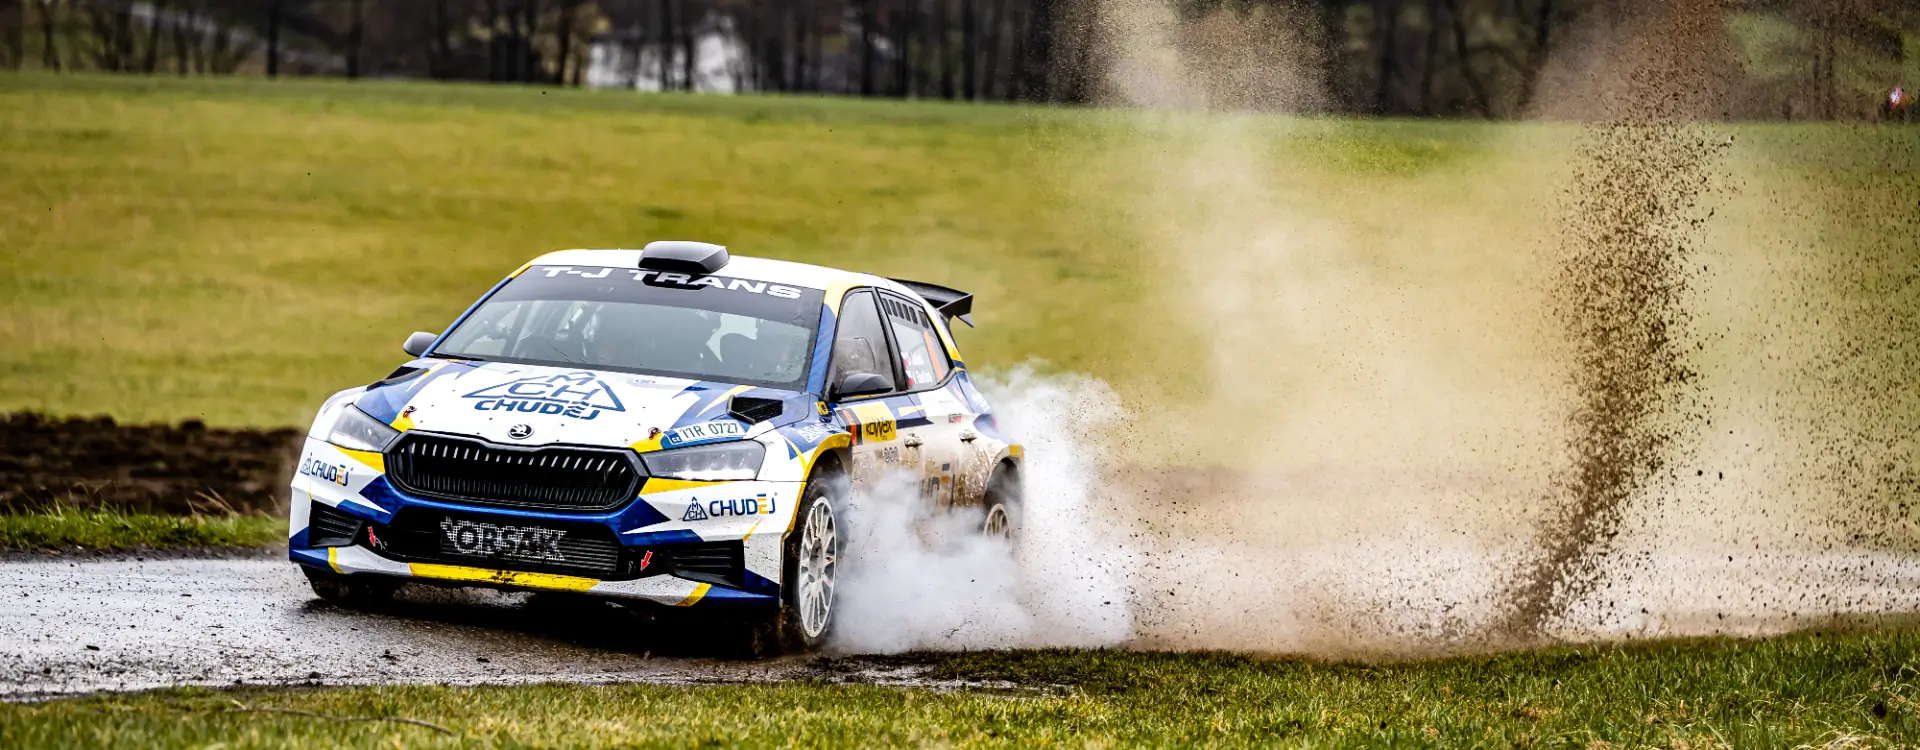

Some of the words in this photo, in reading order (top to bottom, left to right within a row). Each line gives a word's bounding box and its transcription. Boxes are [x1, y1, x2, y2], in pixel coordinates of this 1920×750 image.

[542, 266, 609, 279] T-J
[629, 269, 802, 300] TRANS
[708, 423, 739, 435] 0727
